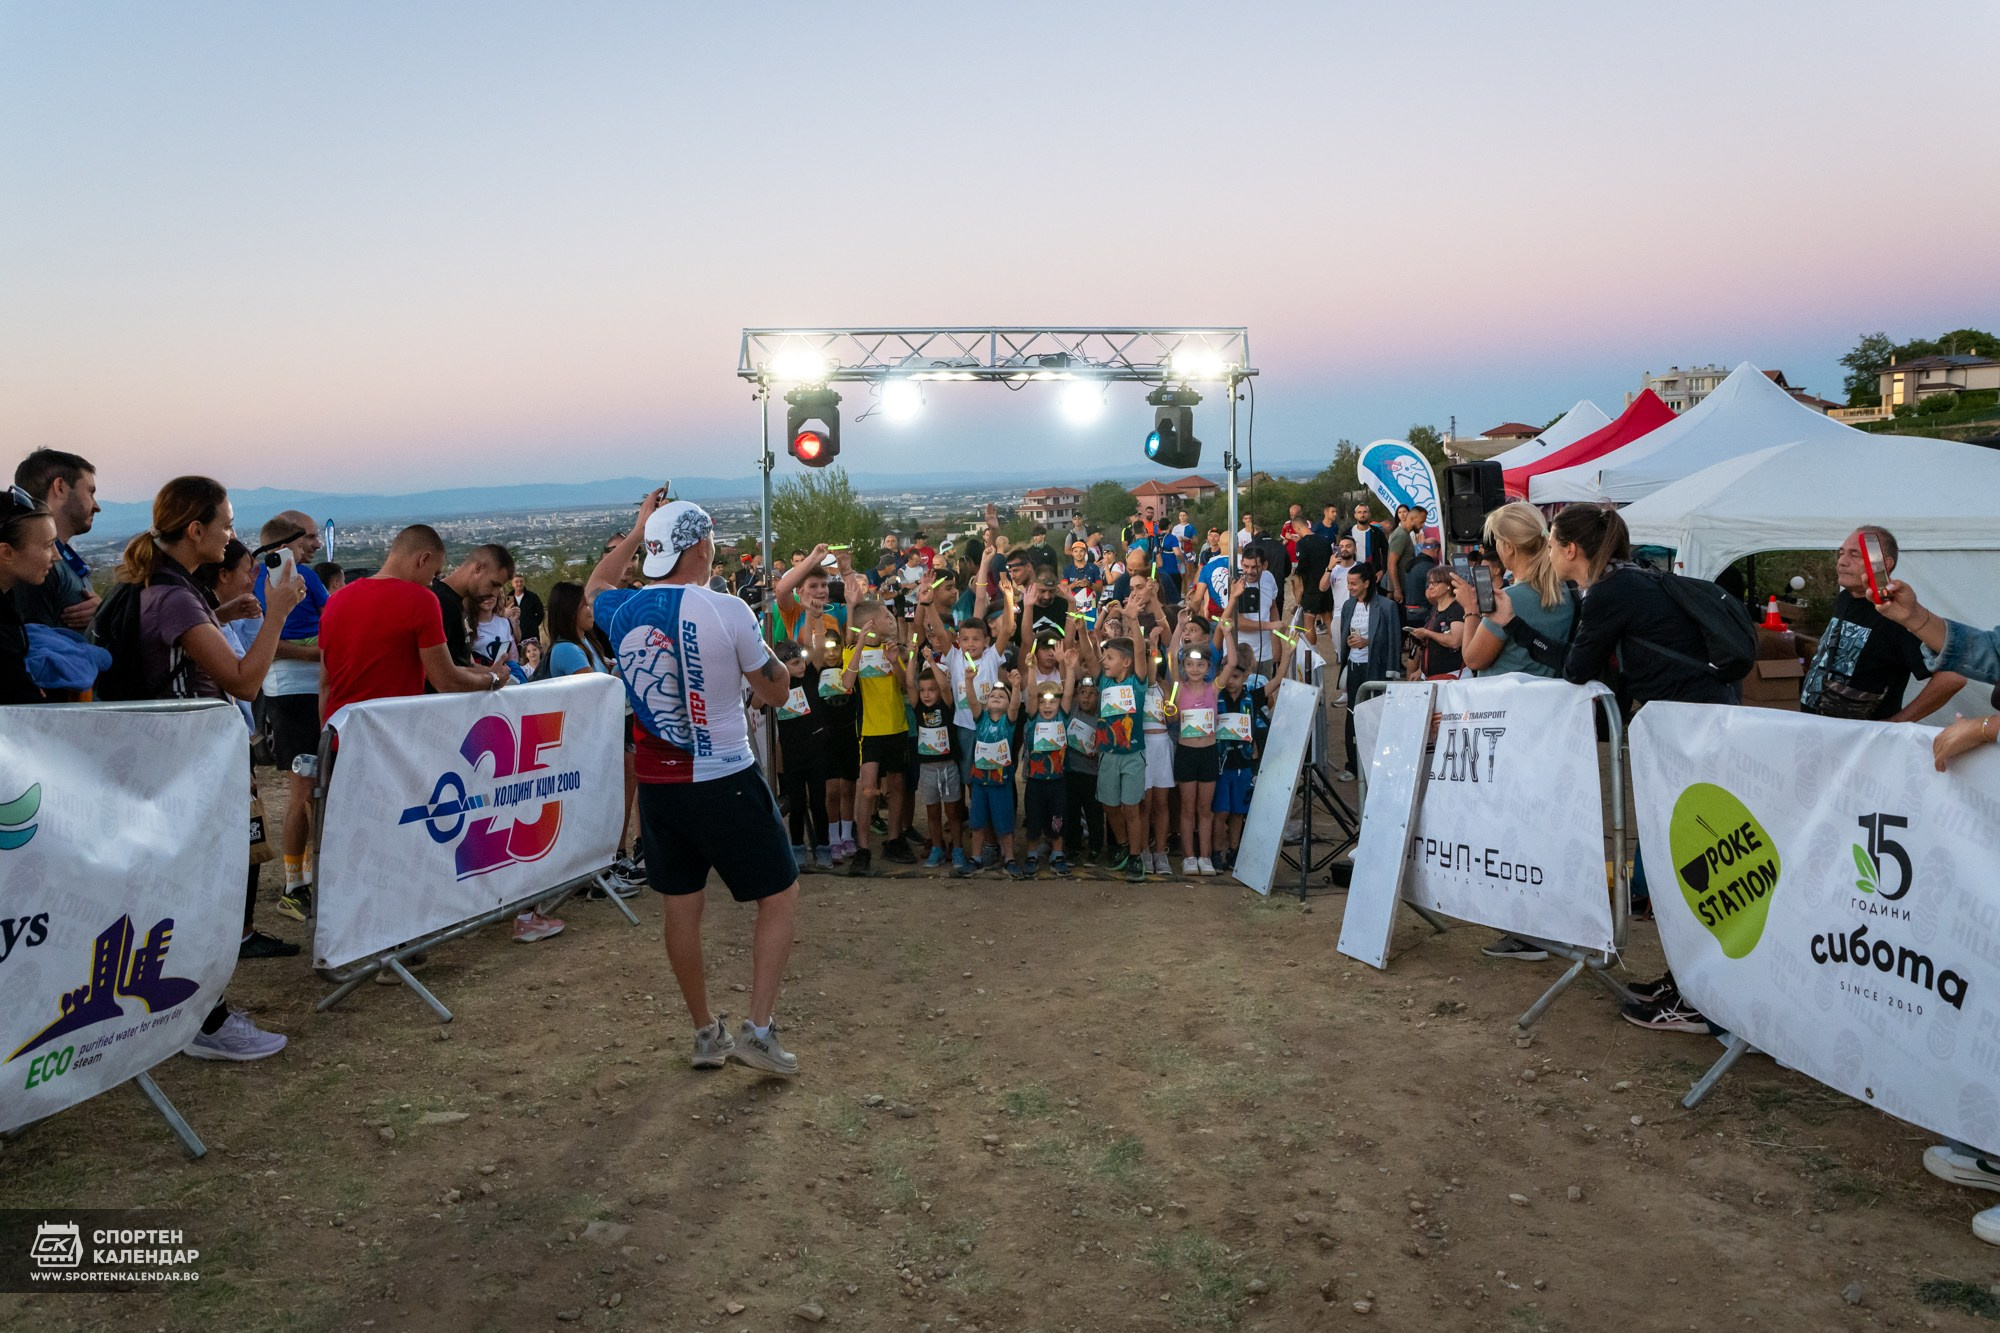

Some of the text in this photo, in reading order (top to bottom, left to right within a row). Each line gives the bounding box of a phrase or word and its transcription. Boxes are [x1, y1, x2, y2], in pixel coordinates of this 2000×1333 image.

[682, 620, 705, 692] MATTERS
[689, 691, 708, 726] STEP
[1119, 688, 1132, 699] 82
[1238, 716, 1249, 727] 48
[1469, 710, 1507, 721] TRANSPORT
[936, 729, 947, 741] 79
[997, 742, 1008, 755] 43
[1429, 727, 1507, 783] ANT
[455, 710, 566, 882] 25
[493, 770, 580, 808] ХОЛДИНГ КЦМ 2000
[1705, 821, 1762, 875] POKE
[1858, 812, 1914, 901] 15
[1698, 859, 1777, 927] STATION
[1851, 898, 1911, 922] ГОДИНИ
[1840, 980, 1923, 1016] SINCE 2010
[78, 1007, 184, 1057] purified water for every day
[25, 1045, 103, 1091] ECO steam
